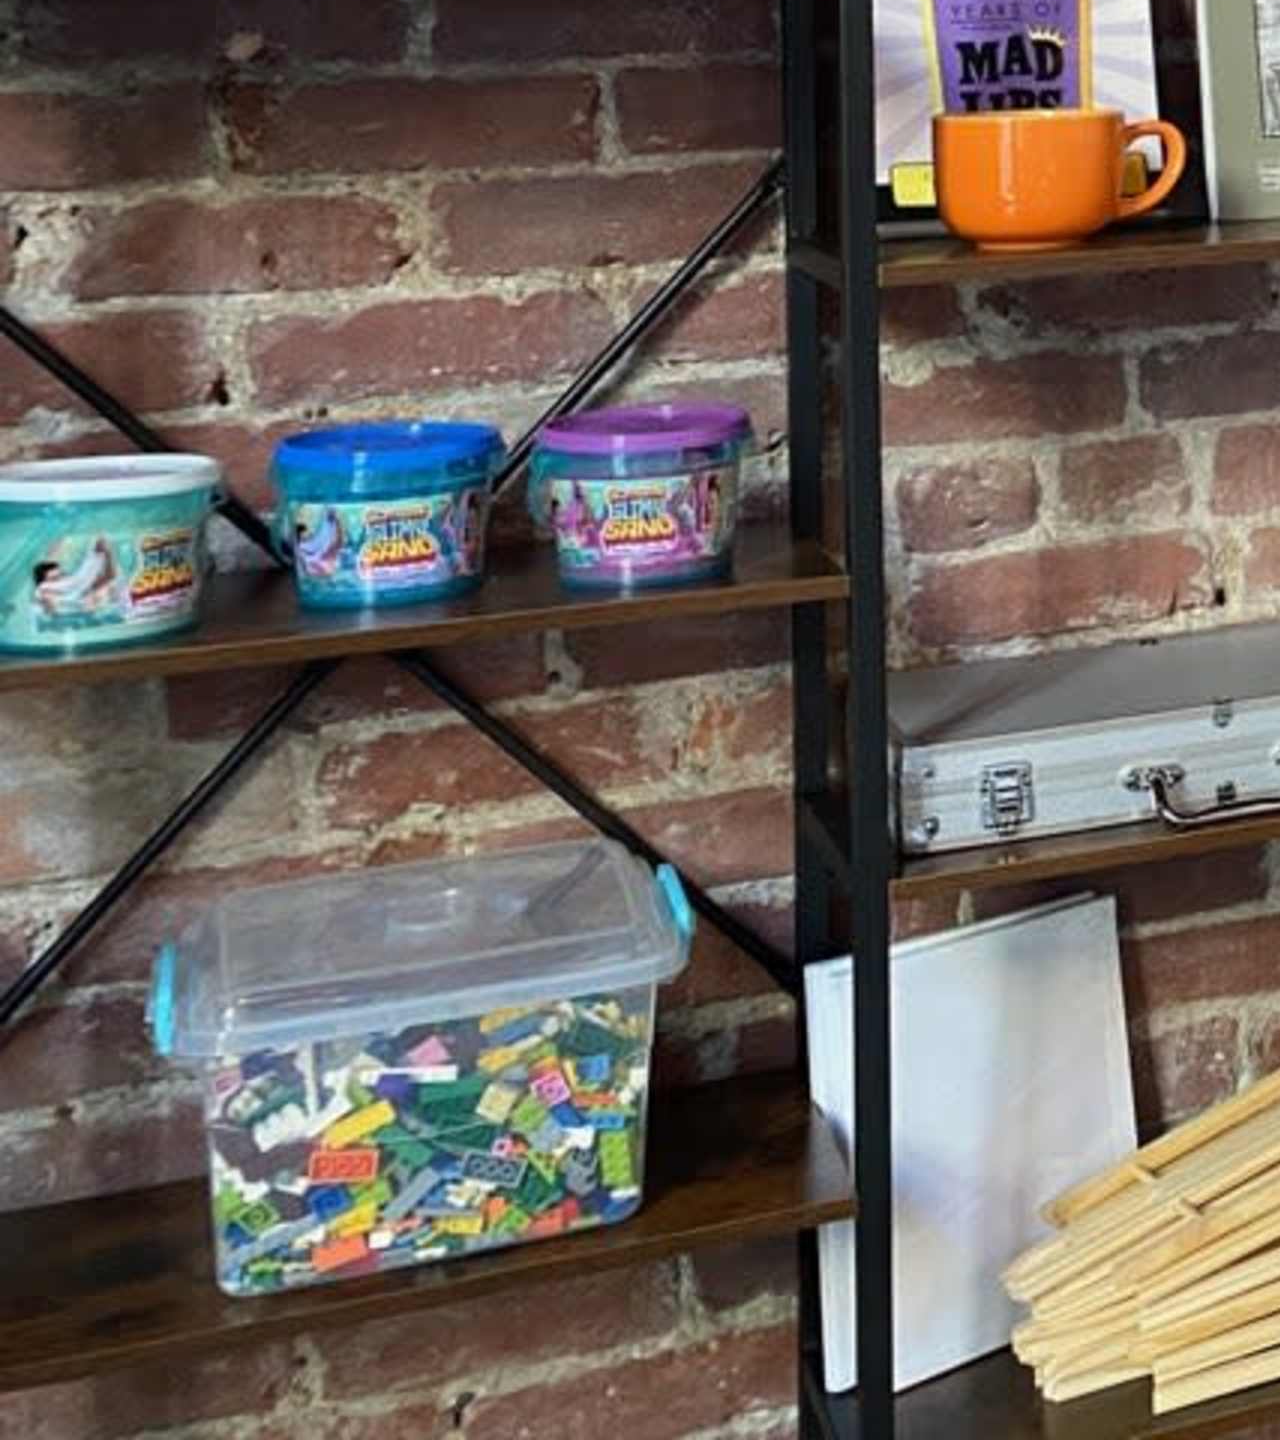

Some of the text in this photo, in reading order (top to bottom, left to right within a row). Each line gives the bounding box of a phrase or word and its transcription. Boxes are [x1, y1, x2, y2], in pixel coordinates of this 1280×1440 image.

[951, 1, 1062, 20] YEARS OF
[956, 34, 1065, 87] MAD
